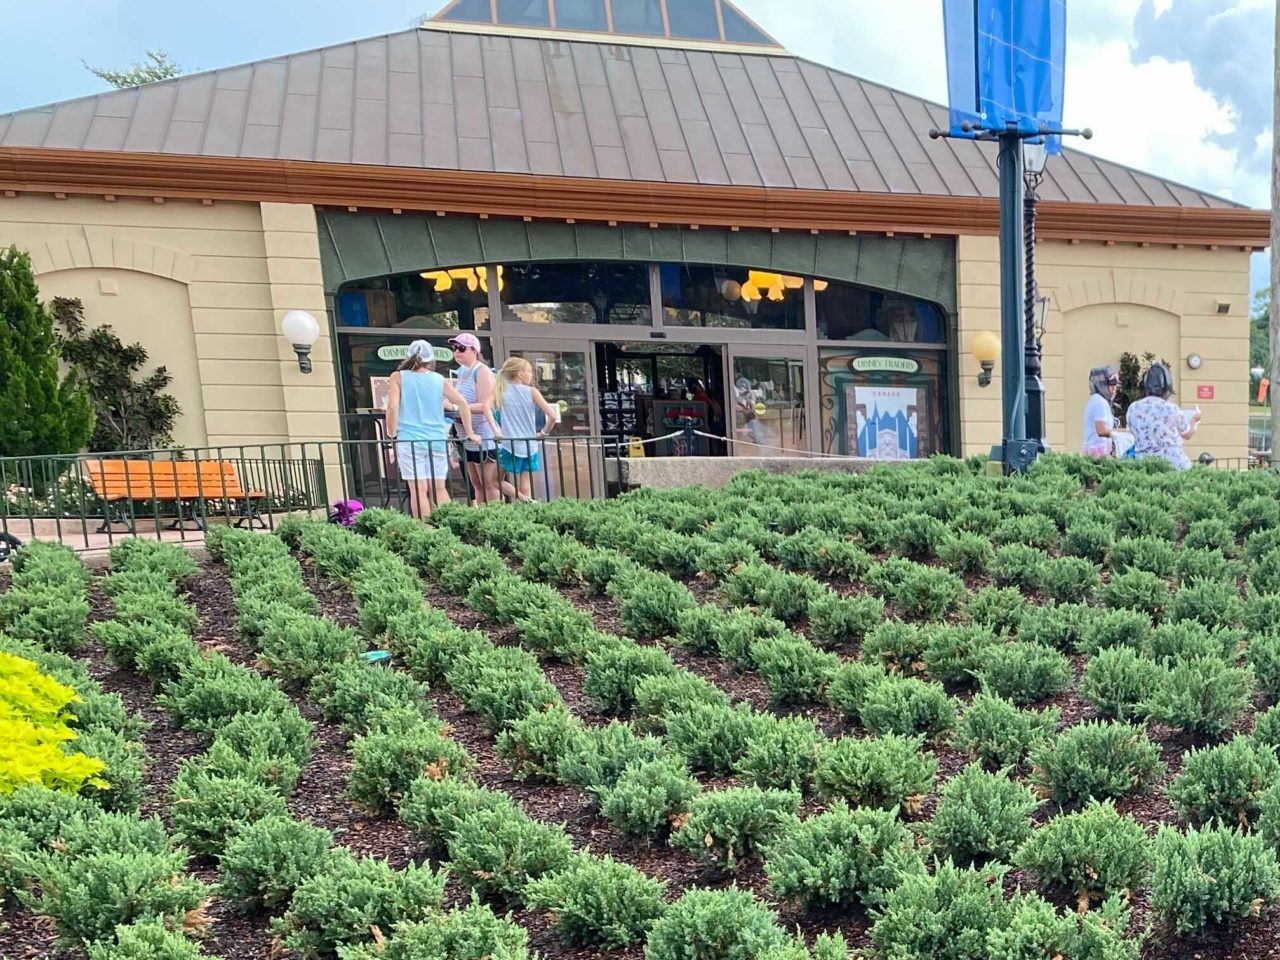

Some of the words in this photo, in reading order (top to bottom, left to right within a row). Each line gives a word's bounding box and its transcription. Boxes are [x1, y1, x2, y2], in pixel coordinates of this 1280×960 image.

[383, 348, 408, 357] DISNE
[857, 359, 881, 369] DISNEY
[885, 359, 914, 370] TRADERS
